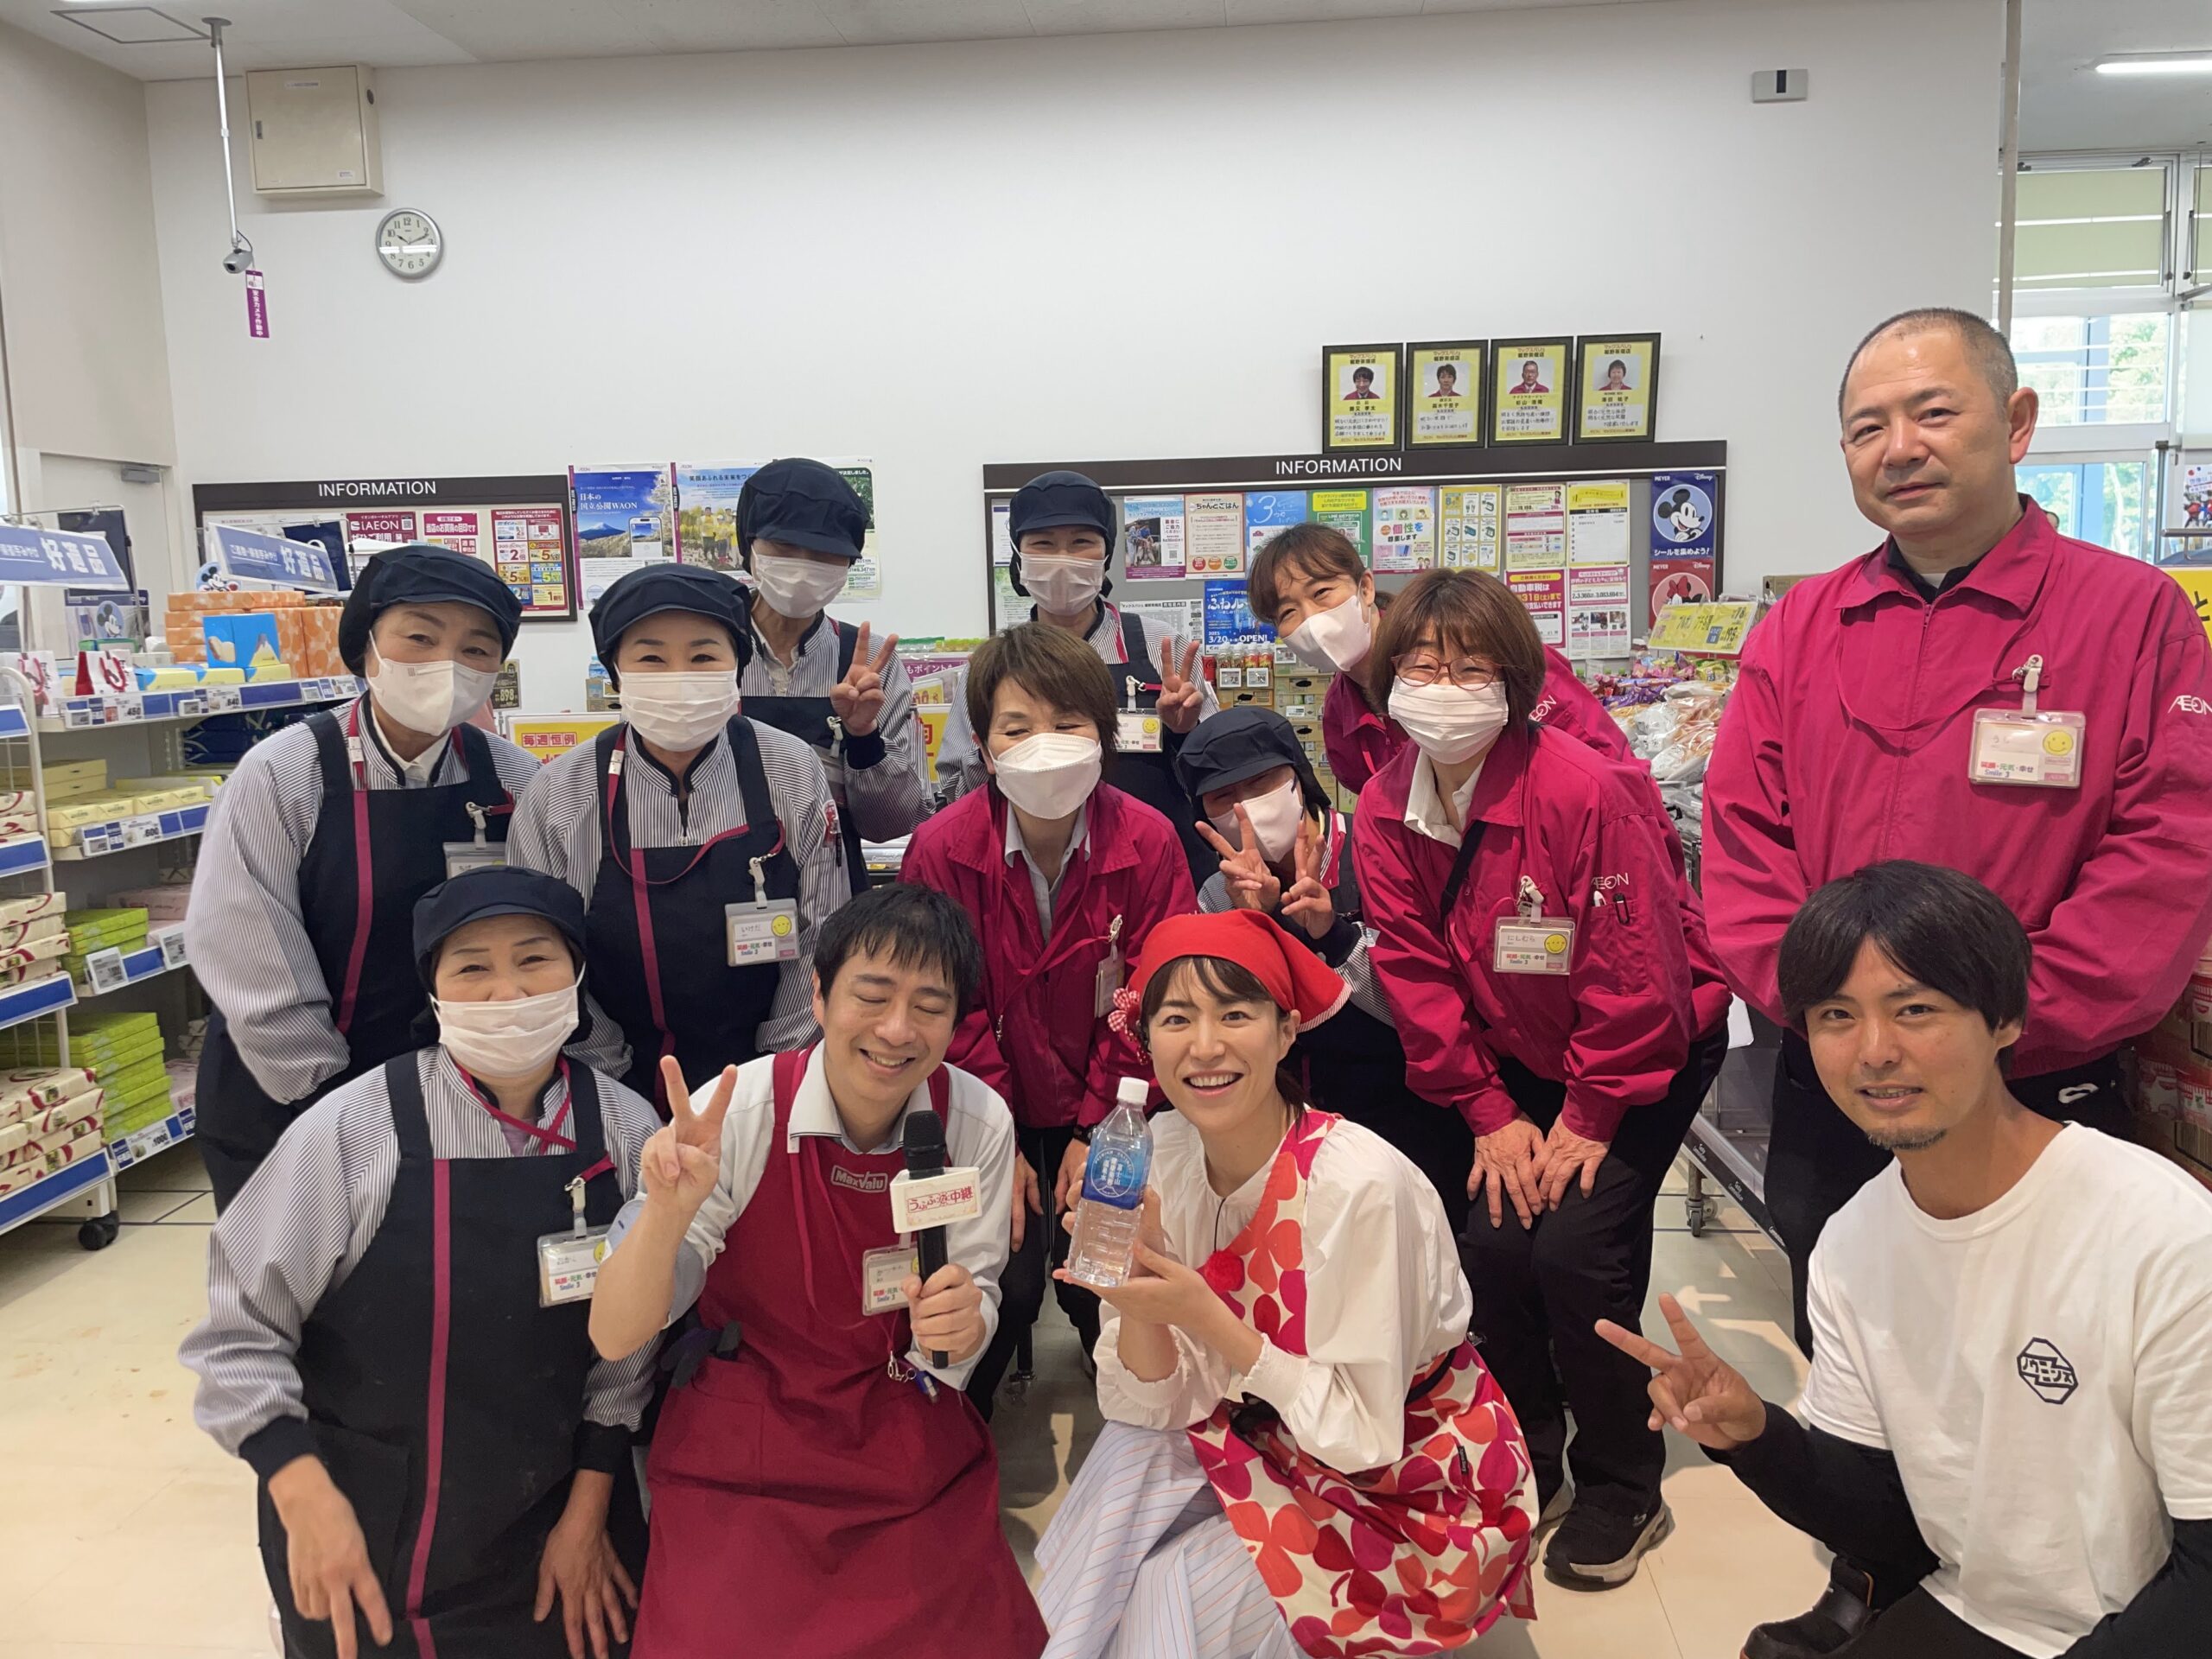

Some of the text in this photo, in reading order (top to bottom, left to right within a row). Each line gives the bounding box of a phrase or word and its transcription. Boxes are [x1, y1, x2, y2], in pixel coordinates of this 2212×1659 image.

[394, 220, 401, 229] 11
[404, 217, 411, 226] 12
[416, 219, 420, 228] 1
[387, 229, 396, 238] 10
[398, 258, 404, 267] 7
[419, 258, 424, 267] 5
[1276, 457, 1402, 476] INFORMATION
[1694, 473, 1713, 482] Disney
[319, 480, 436, 497] INFORMATION
[580, 493, 601, 501] 日本の
[580, 502, 638, 511] 国立公園WAON
[1254, 495, 1276, 524] 3
[361, 520, 399, 531] iAEON
[1393, 522, 1424, 535] 個性を
[1388, 533, 1418, 543] 尊重します
[1654, 548, 1710, 556] シールを集めよう!
[1693, 562, 1711, 570] Disney
[1510, 583, 1549, 593] 自動車税は
[1239, 634, 1268, 643] OPEN!
[499, 689, 514, 702] 898
[523, 734, 575, 745] 毎週恒例
[835, 1169, 884, 1190] MaxValu
